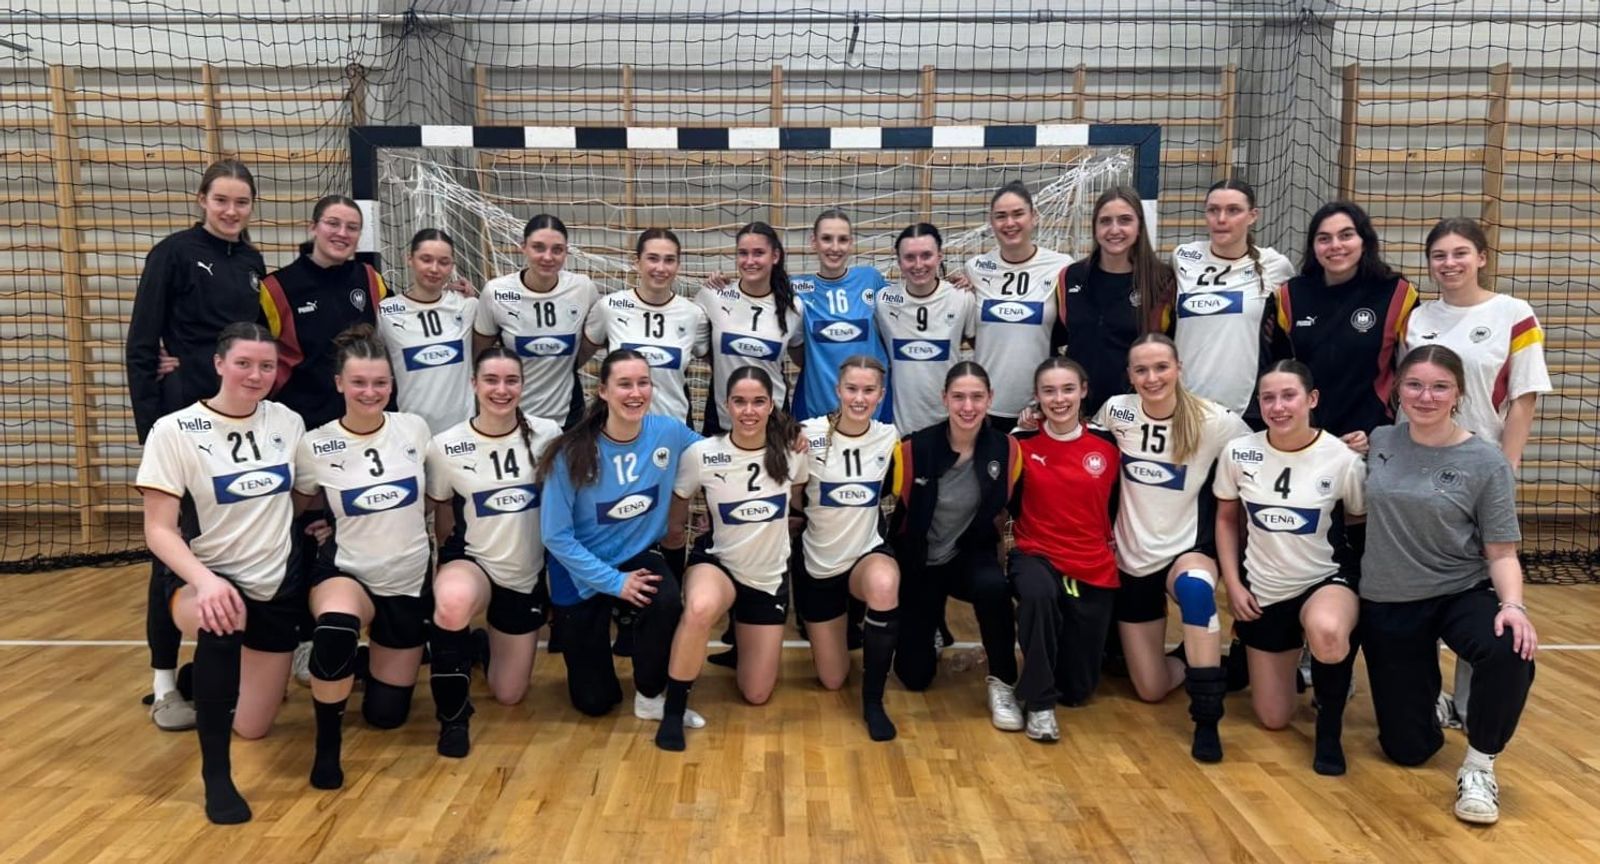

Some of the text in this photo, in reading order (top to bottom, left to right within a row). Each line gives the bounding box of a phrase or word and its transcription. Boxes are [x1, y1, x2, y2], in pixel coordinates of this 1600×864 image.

[1178, 247, 1203, 260] hella
[975, 259, 997, 271] hella
[1197, 265, 1231, 286] 22
[1001, 271, 1030, 296] 20
[495, 290, 521, 301] hella
[826, 288, 849, 315] 16
[882, 292, 904, 304] hella
[378, 303, 406, 315] hella
[609, 297, 635, 309] hella
[1190, 299, 1221, 309] TENA
[533, 301, 557, 328] 18
[997, 306, 1024, 316] TENA
[417, 309, 443, 338] 10
[643, 312, 665, 339] 13
[750, 306, 763, 332] 7
[916, 306, 928, 332] 9
[827, 327, 853, 337] TENA
[533, 341, 561, 351] TENA
[737, 342, 763, 353] TENA
[907, 345, 933, 355] TENA
[422, 349, 450, 360] TENA
[642, 351, 665, 361] ENA
[1110, 406, 1135, 422] hella
[177, 418, 212, 432] hella
[1141, 423, 1167, 454] 15
[227, 430, 262, 463] 21
[313, 439, 346, 455] hella
[444, 441, 476, 455] hella
[702, 453, 732, 465] hella
[842, 448, 863, 477] 11
[1232, 449, 1263, 462] hella
[364, 448, 385, 478] 3
[489, 448, 520, 480] 14
[613, 452, 640, 486] 12
[747, 462, 761, 492] 2
[1133, 466, 1162, 479] TENA
[237, 477, 273, 491] TENA
[1273, 467, 1291, 499] 4
[363, 491, 399, 506] TENA
[494, 493, 527, 506] TENA
[839, 490, 867, 500] TENA
[617, 501, 645, 515] TENA
[740, 506, 770, 517] TENA
[1262, 513, 1295, 525] TENA
